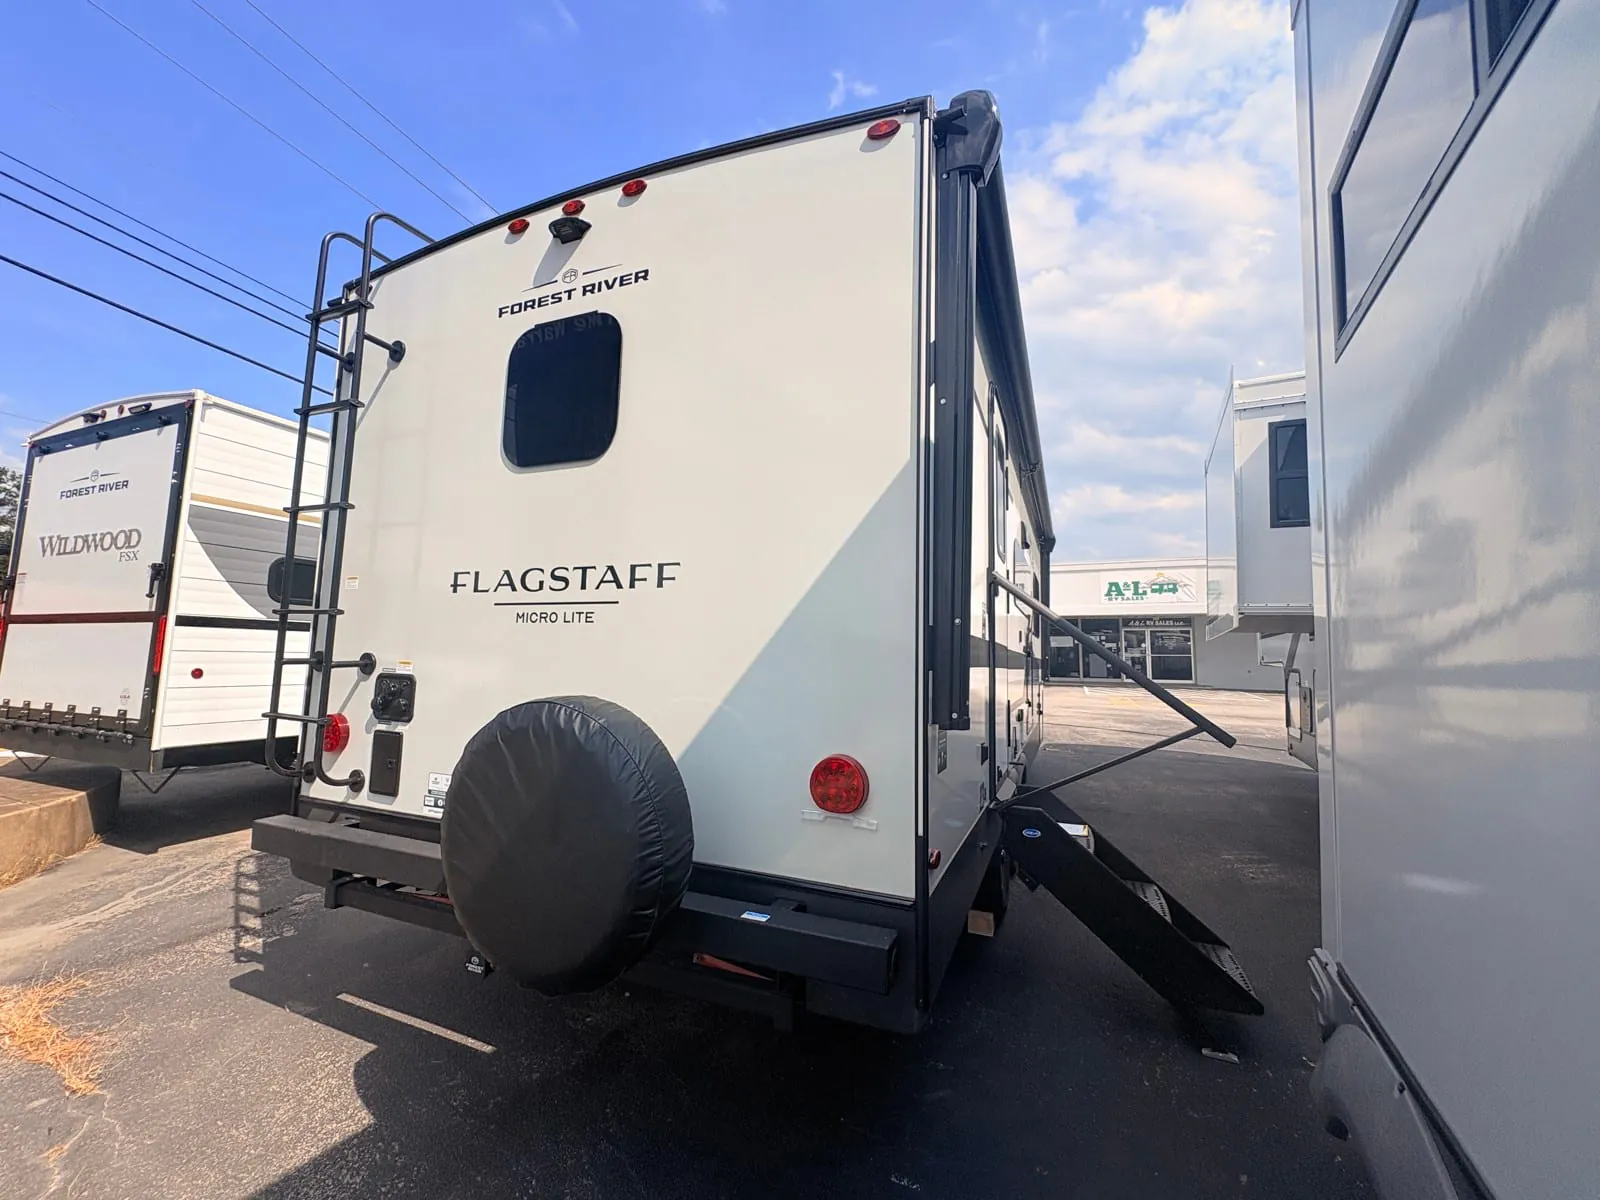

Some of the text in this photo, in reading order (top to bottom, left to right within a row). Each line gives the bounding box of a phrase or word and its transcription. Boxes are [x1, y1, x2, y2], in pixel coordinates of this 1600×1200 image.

[497, 268, 650, 318] FOREST RIVER
[59, 479, 129, 500] FOREST RIVER
[118, 550, 139, 562] FSX
[450, 562, 681, 594] FLAGSTAFF
[515, 611, 595, 624] MICRO LITE
